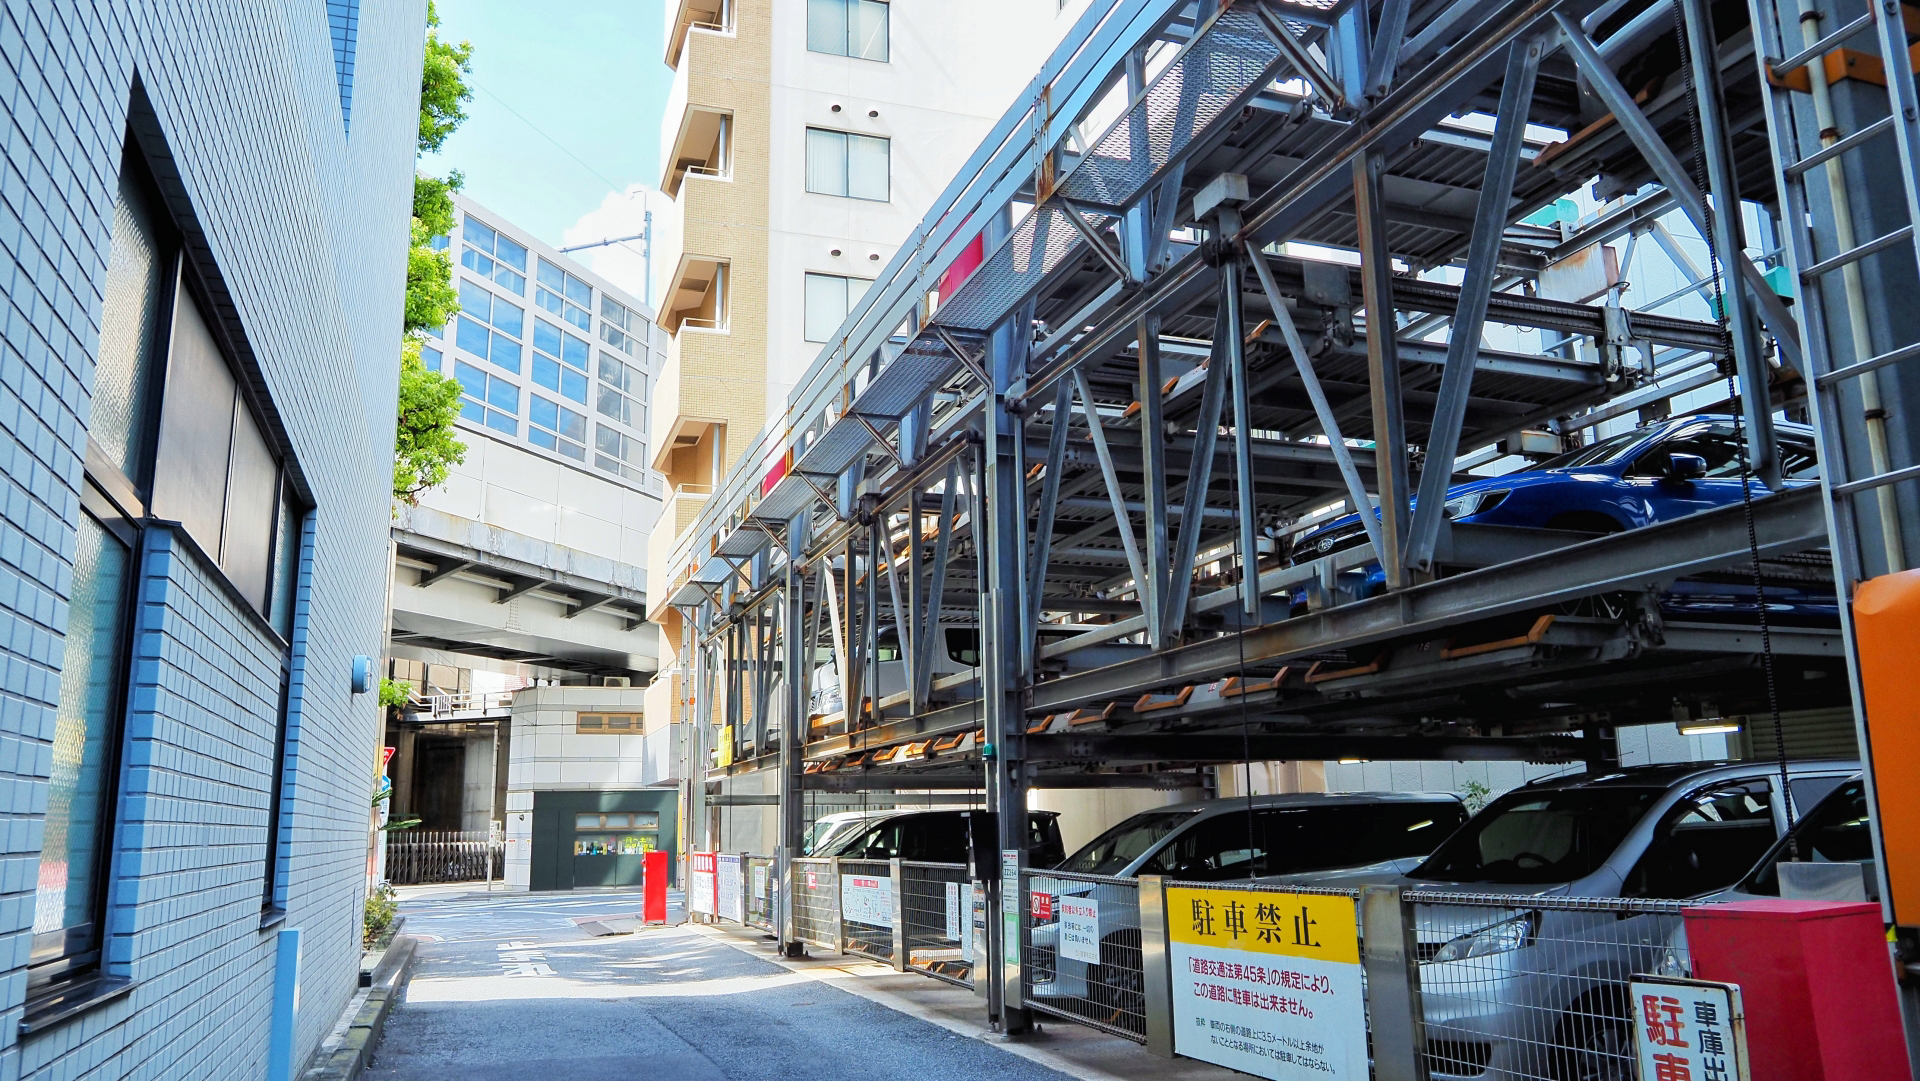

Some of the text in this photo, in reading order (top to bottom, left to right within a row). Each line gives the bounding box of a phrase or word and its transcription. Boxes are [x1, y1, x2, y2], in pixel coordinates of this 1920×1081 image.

[1191, 898, 1322, 948] 駐車禁止
[1188, 956, 1335, 995] 「道路交通法第45条」の規定により、
[1193, 982, 1314, 1019] この道路に駐車は出来ません。
[1693, 1000, 1728, 1081] 車庫出
